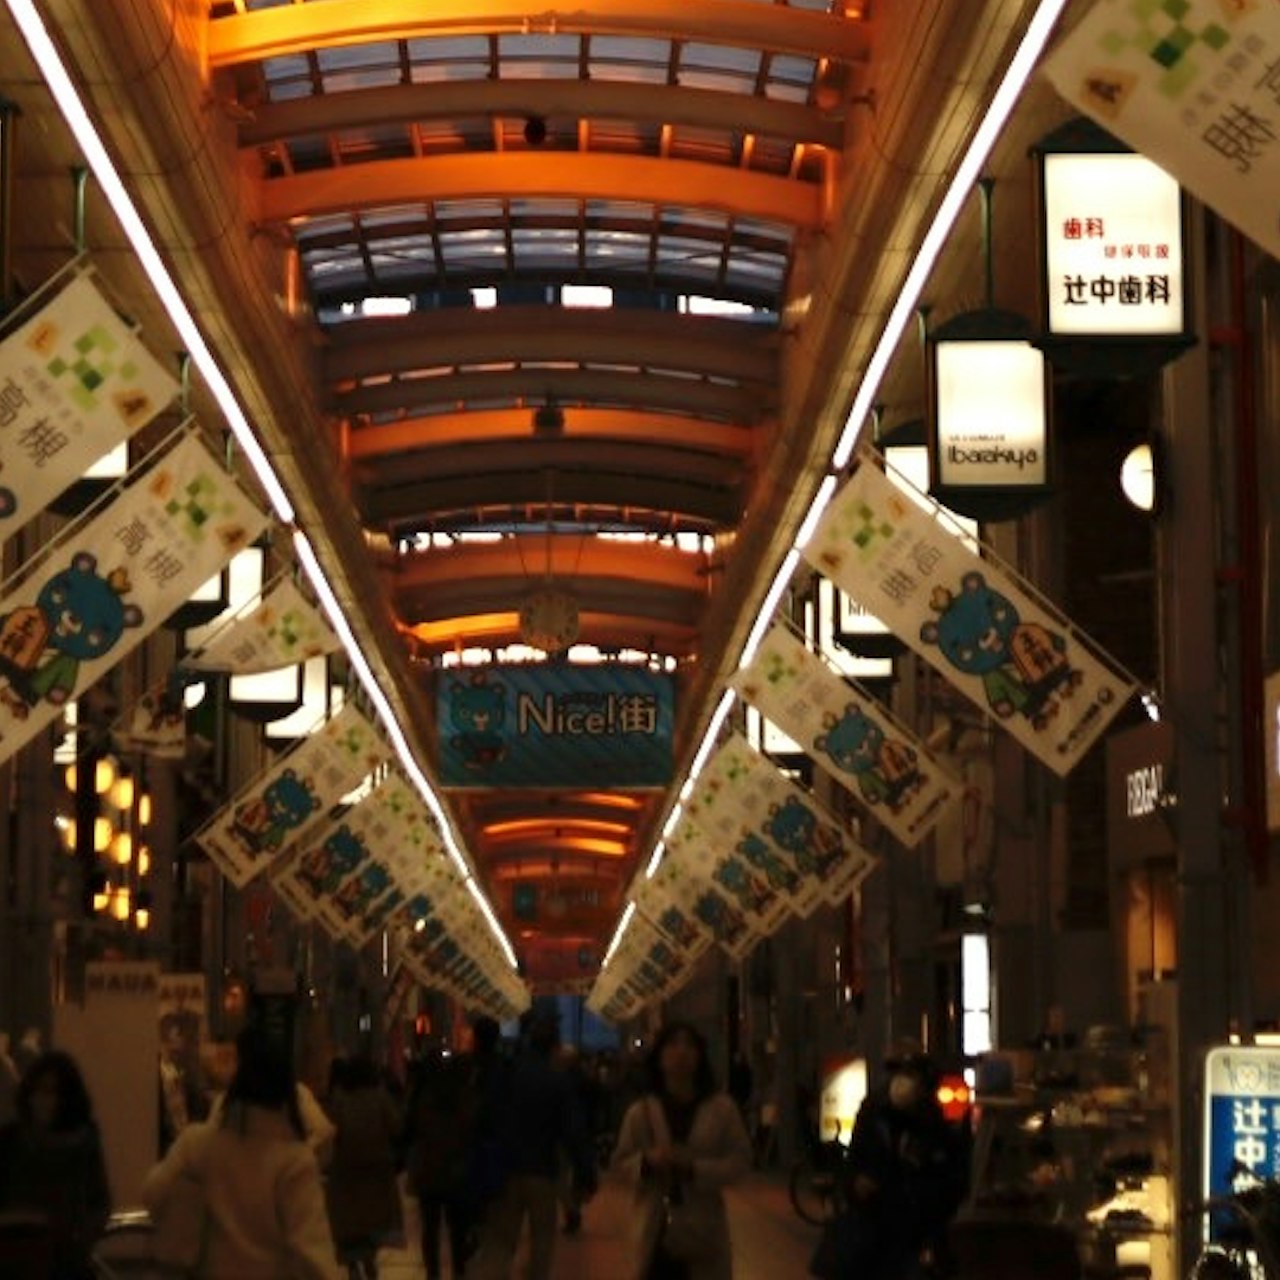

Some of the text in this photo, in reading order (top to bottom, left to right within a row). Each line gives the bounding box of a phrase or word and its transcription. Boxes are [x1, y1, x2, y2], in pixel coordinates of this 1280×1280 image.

[1063, 218, 1104, 239] 歯科
[1063, 274, 1171, 306] 辻中歯科
